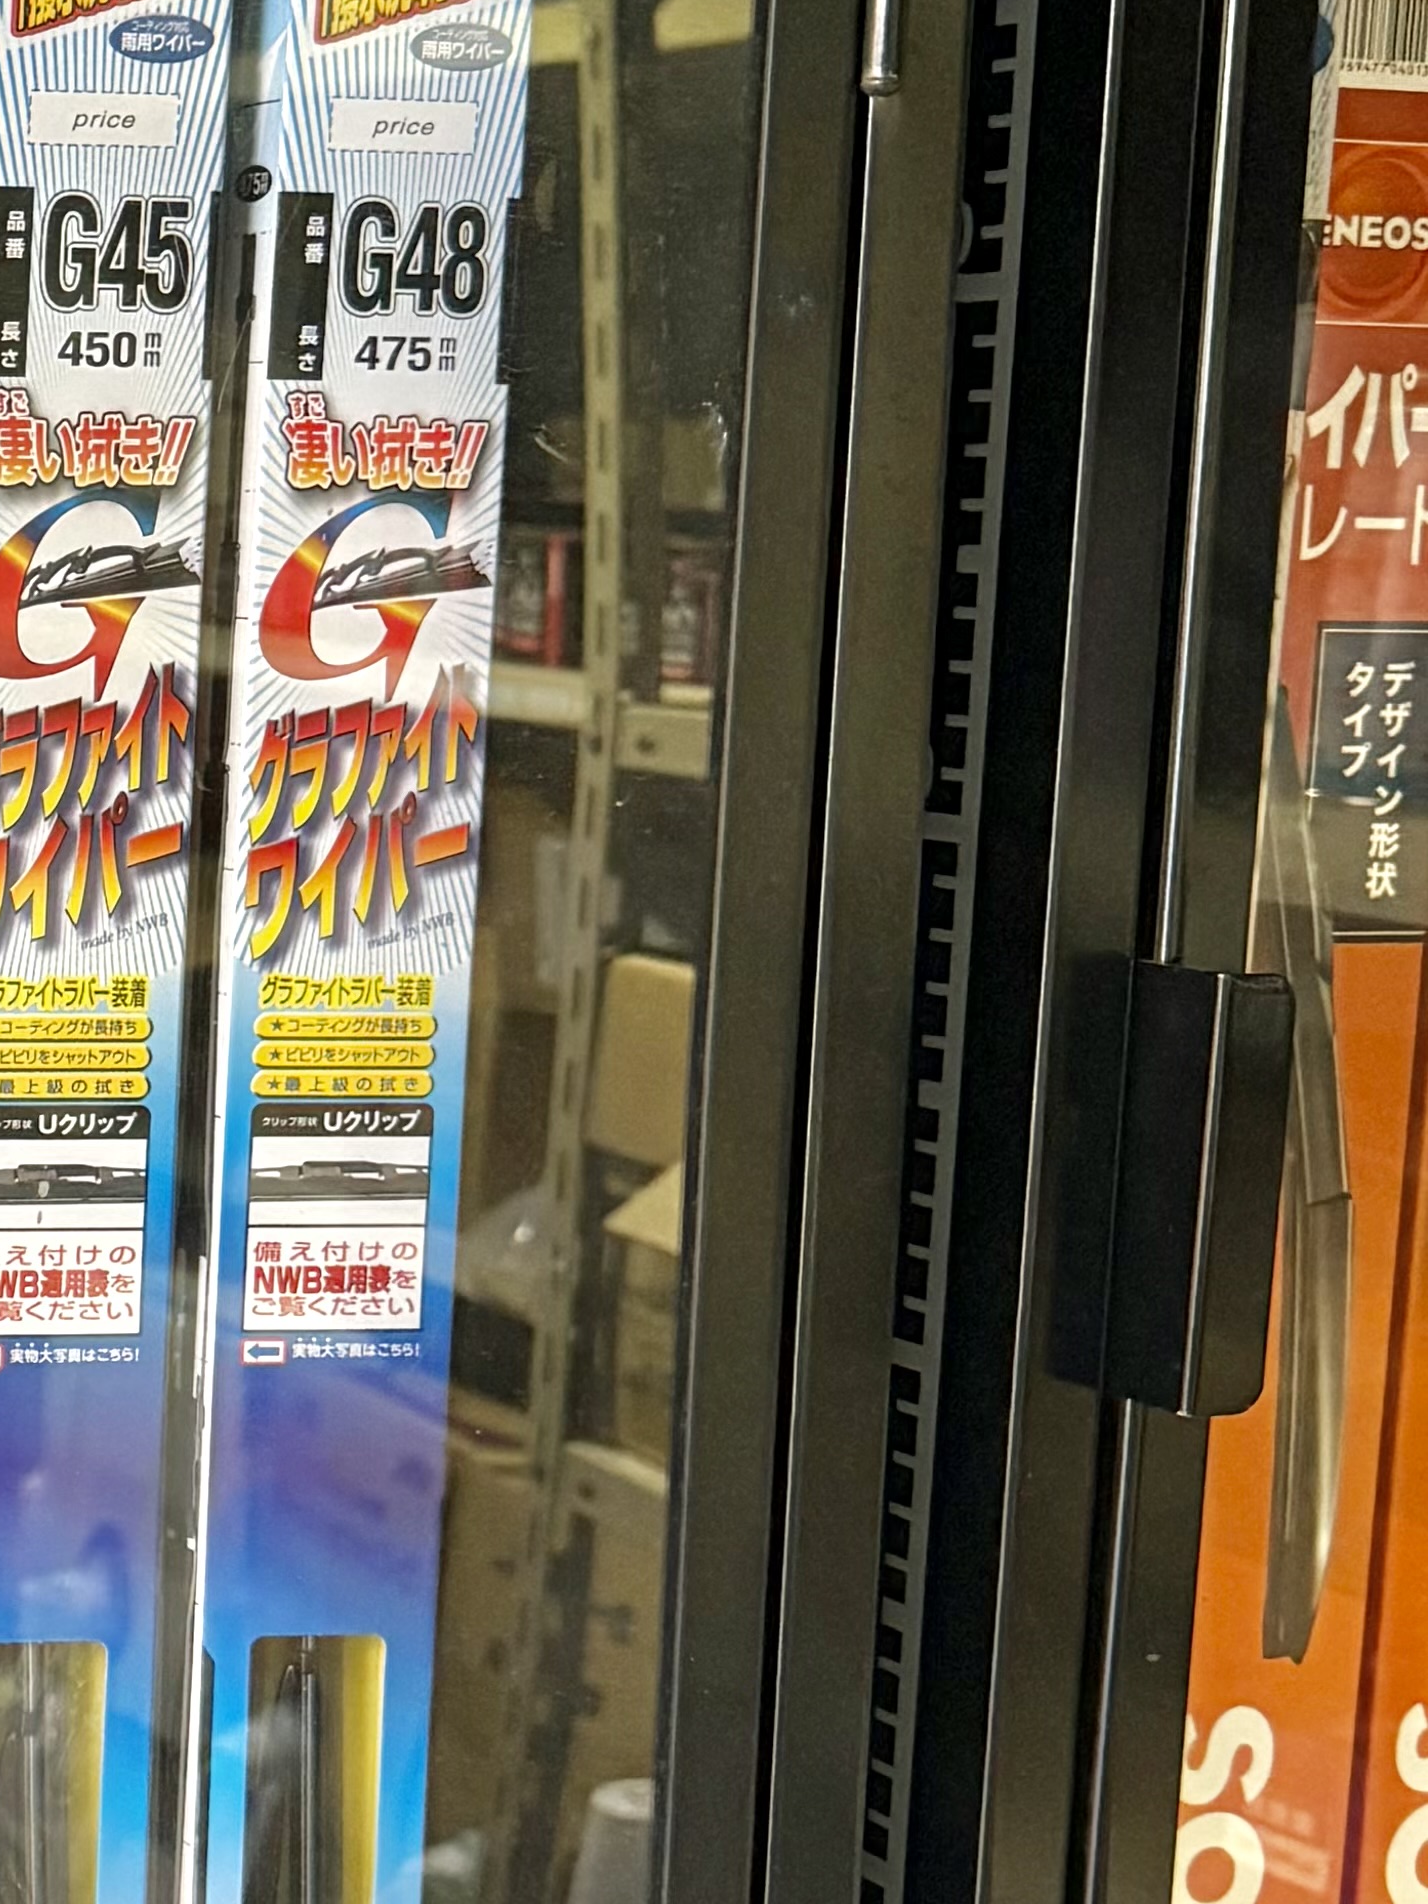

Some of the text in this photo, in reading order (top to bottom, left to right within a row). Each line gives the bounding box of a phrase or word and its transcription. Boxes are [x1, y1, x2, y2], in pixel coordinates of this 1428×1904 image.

[120, 32, 206, 52] 雨用ワイパー
[420, 40, 505, 61] 雨用ワイパー
[72, 109, 137, 131] price
[373, 116, 435, 137] price
[43, 190, 193, 315] G45
[341, 195, 489, 319] G48
[1339, 662, 1376, 777] タイプ
[248, 663, 478, 841] グラファイト
[1366, 661, 1416, 899] デザイン形状
[246, 792, 469, 961] ワイパー
[259, 975, 432, 1008] グラファイトラバー装着
[324, 1108, 422, 1132] Uクリップ
[254, 1241, 418, 1263] 備え付けの
[253, 1296, 416, 1317] ご覧ください
